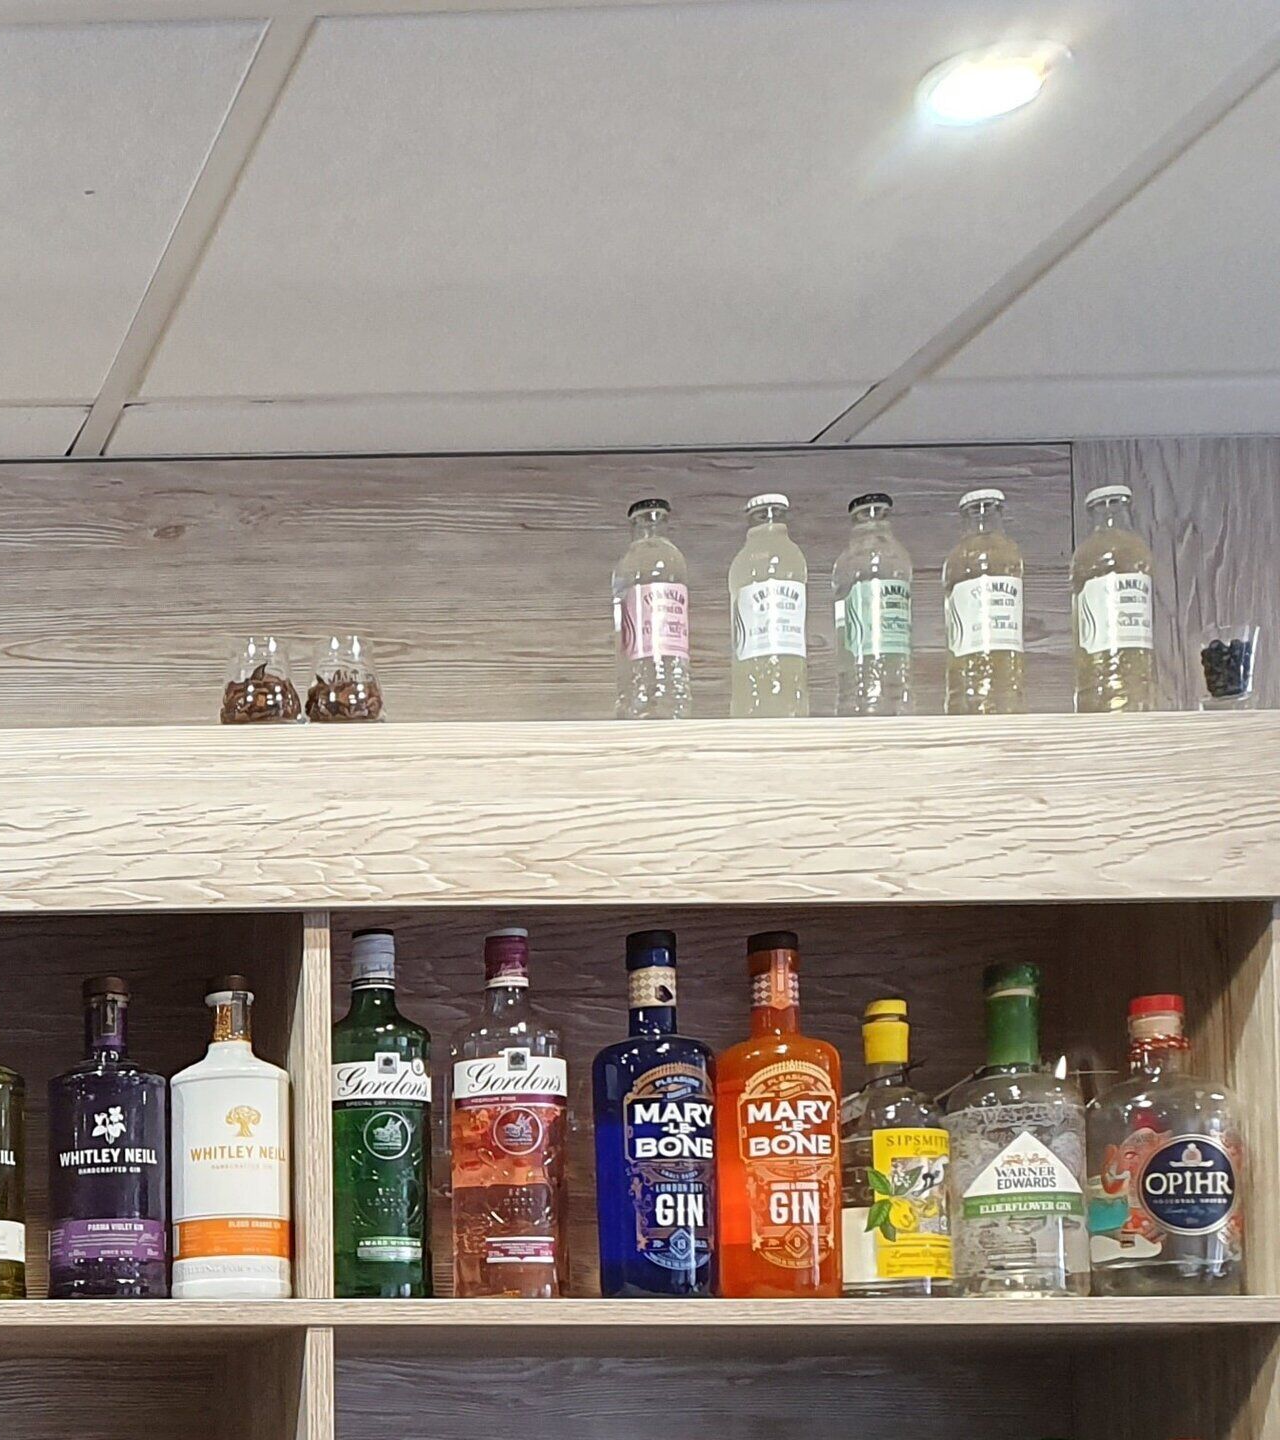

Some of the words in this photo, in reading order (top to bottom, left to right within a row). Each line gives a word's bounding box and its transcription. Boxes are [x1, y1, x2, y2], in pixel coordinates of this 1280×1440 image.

[337, 1066, 429, 1098] Gordon's
[466, 1063, 562, 1094] Gordon's
[634, 1101, 714, 1128] MARY
[747, 1100, 832, 1125] MARY
[59, 1148, 121, 1167] WHITLEY
[124, 1147, 158, 1166] NEILL
[191, 1145, 253, 1162] WHITLEY
[259, 1145, 287, 1162] NEILL
[634, 1132, 713, 1159] BONE
[749, 1132, 832, 1157] BONE
[993, 1165, 1057, 1178] WARNER
[996, 1176, 1057, 1191] EDWARDS
[1144, 1170, 1233, 1196] OPIHR
[655, 1193, 705, 1227] GIN
[769, 1191, 820, 1224] GIN
[979, 1202, 1054, 1215] ELDERFLOWER
[1054, 1200, 1072, 1212] GIN
